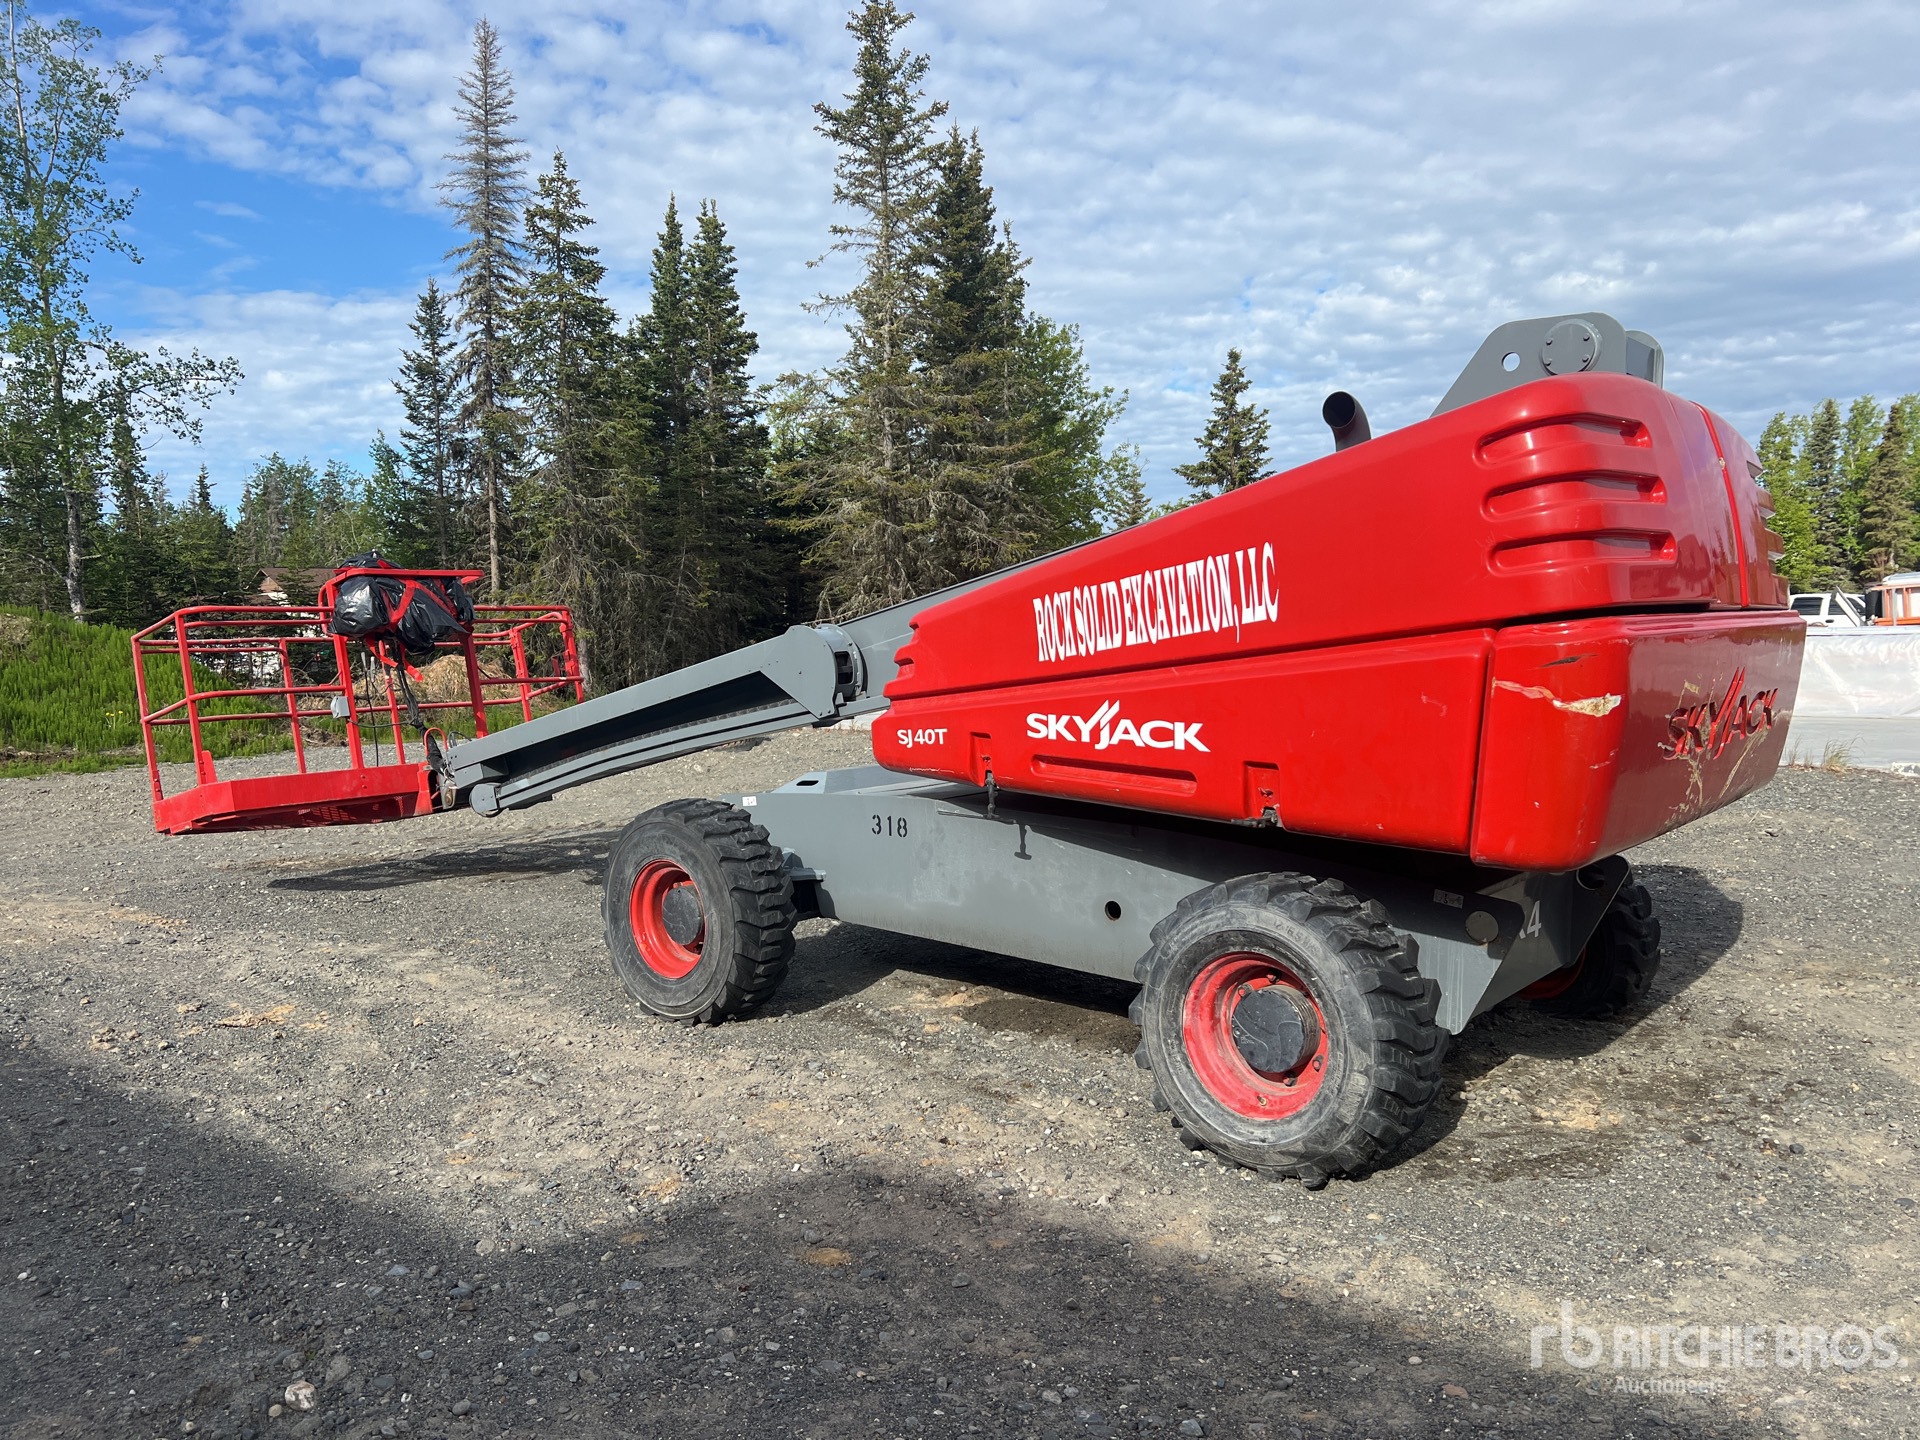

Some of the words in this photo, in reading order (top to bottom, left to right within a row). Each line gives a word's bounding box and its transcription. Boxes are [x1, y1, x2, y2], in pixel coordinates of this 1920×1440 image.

[1033, 590, 1077, 662] ROCK
[1073, 580, 1122, 657] SOLID
[1120, 553, 1240, 643] EXCAVATION,
[1235, 541, 1280, 624] LLC
[1026, 699, 1211, 753] SKYJACK
[1663, 666, 1778, 760] SKYJACK
[896, 728, 948, 749] SJ40T
[871, 814, 908, 838] 318
[1518, 900, 1542, 940] 4
